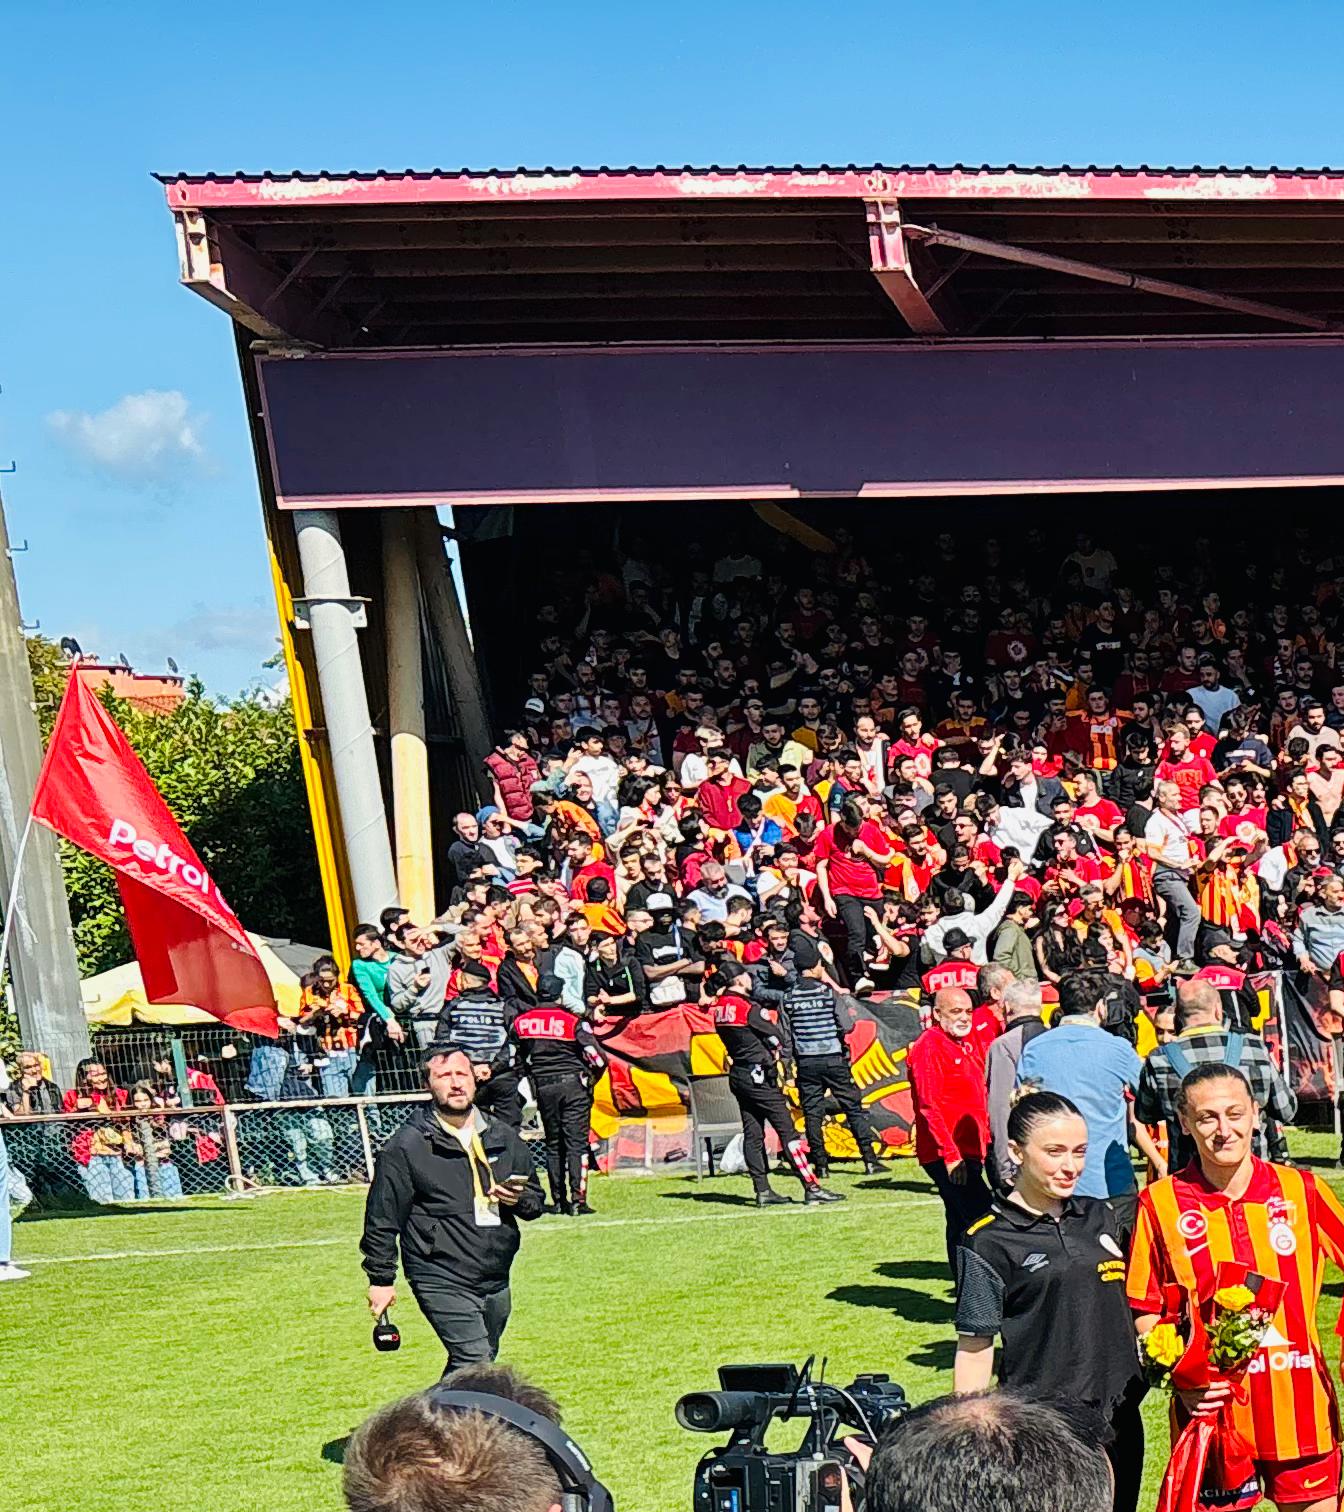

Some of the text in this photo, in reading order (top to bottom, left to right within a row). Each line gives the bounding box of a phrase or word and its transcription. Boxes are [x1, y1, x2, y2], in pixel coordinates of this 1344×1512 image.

[108, 818, 210, 895] Petrol
[929, 970, 979, 990] POLİS
[518, 1015, 566, 1037] POLİS
